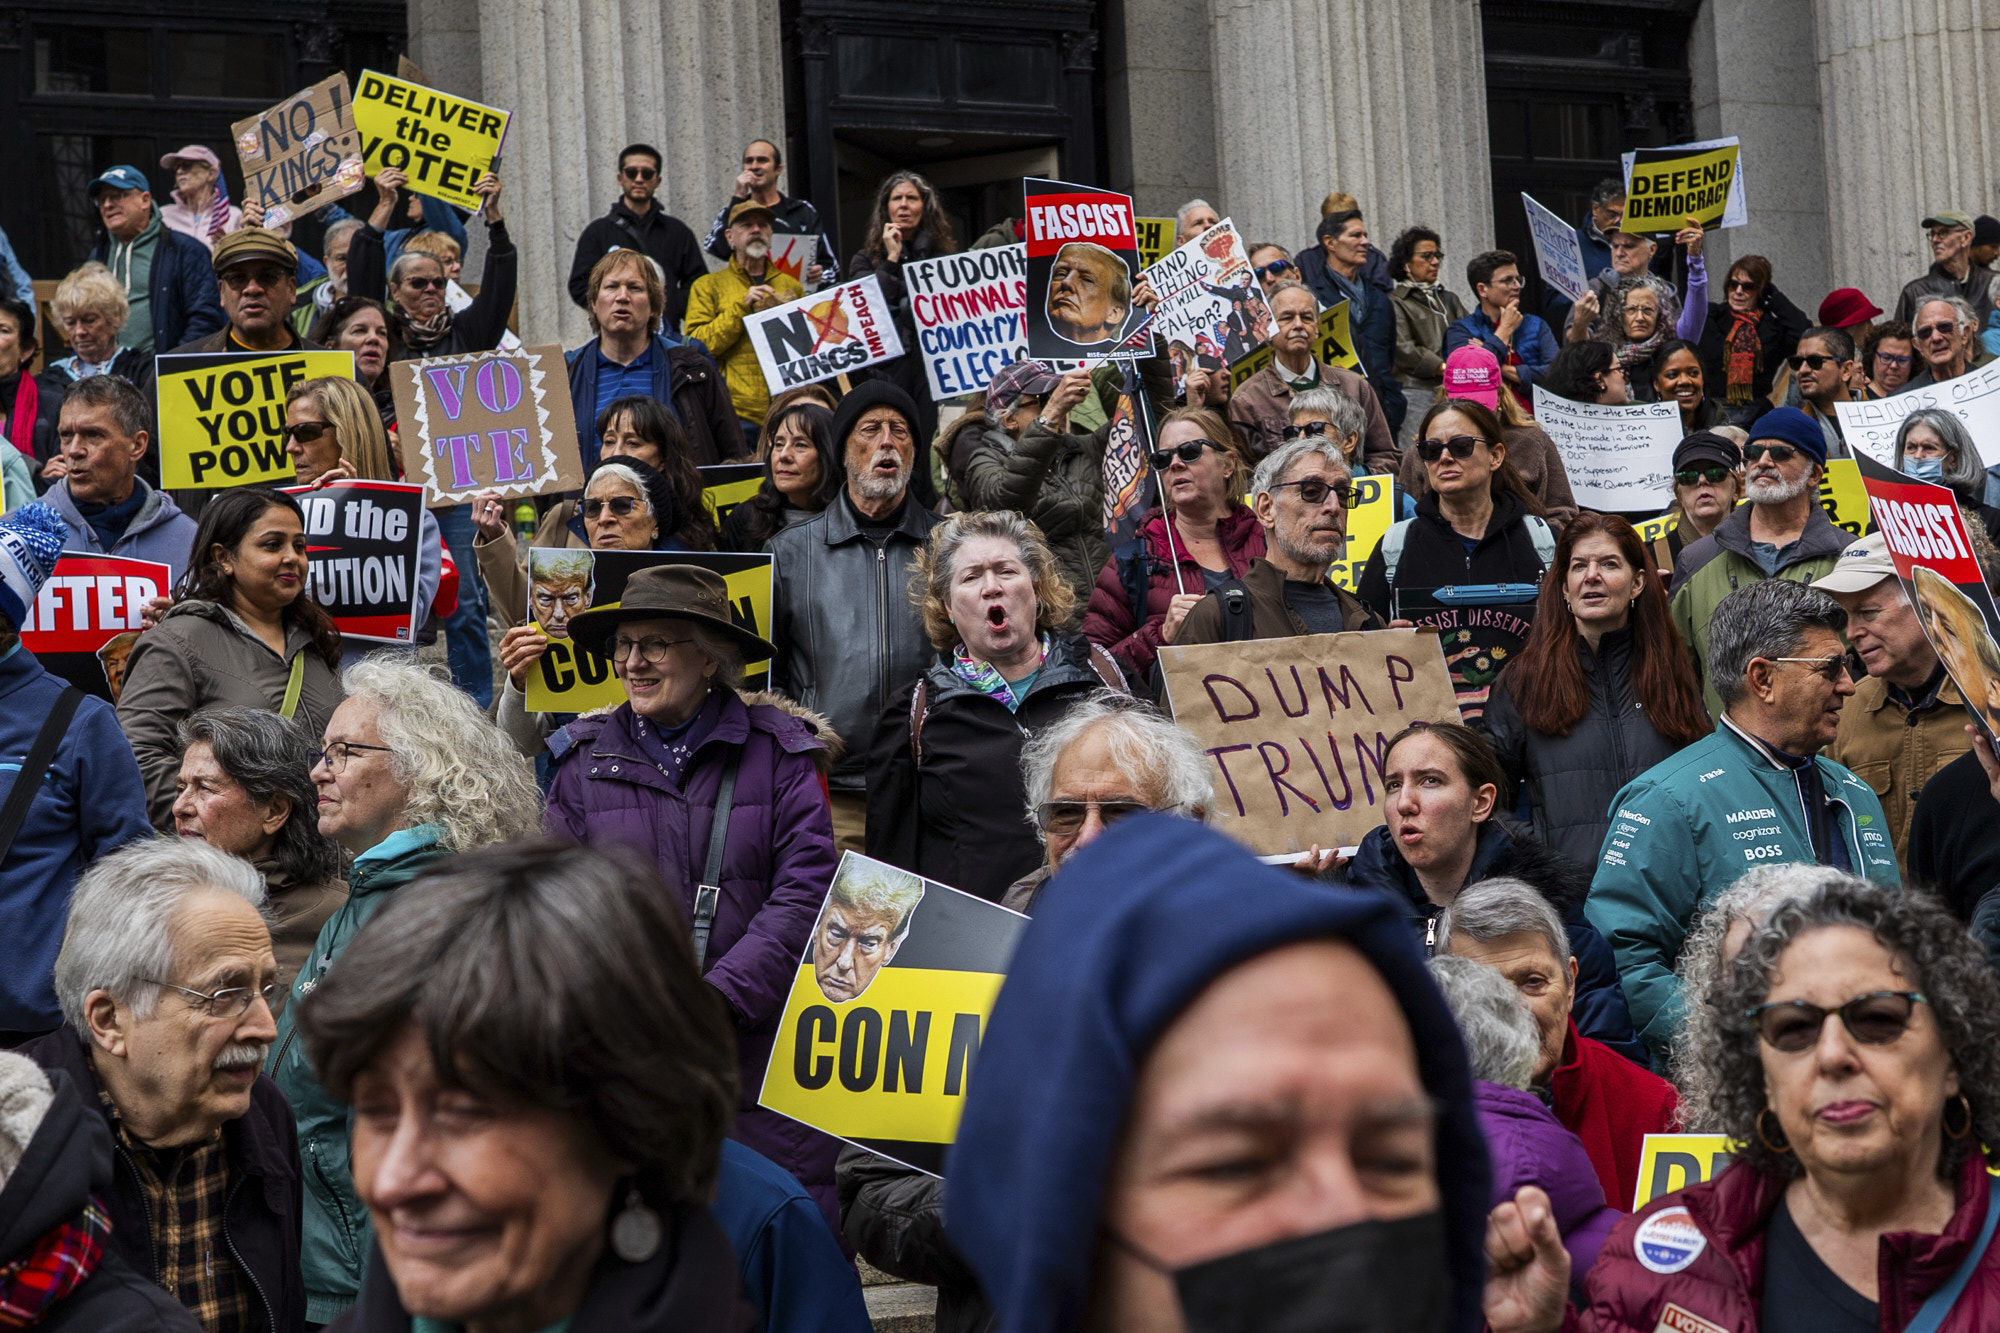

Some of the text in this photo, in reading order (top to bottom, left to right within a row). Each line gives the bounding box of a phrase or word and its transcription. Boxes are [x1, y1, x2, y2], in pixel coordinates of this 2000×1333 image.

[361, 77, 502, 139] DELIVER
[261, 101, 315, 162] NO
[396, 116, 451, 152] the
[256, 137, 342, 209] KINGS
[358, 131, 482, 196] VOTE!
[1632, 159, 1731, 196] DEFEND
[1629, 179, 1732, 219] DEMOCRACY
[1030, 203, 1131, 241] FASCIST
[1200, 223, 1230, 249] ATOMS
[1177, 284, 1203, 305] WILL
[848, 284, 886, 358] IMPEACH
[1157, 307, 1196, 336] FALL
[1188, 299, 1223, 335] FOR?
[777, 341, 868, 387] KINGS
[425, 359, 523, 421] VO
[1844, 369, 2000, 425] HANDS OFF
[1577, 421, 1599, 431] War
[1617, 424, 1647, 433] Iran
[1625, 407, 1647, 417] Fed
[1866, 429, 1896, 441] Our
[435, 428, 534, 490] TE
[1103, 444, 1141, 529] AMERIC
[344, 499, 409, 542] the
[1870, 495, 1970, 560] FASCIST
[7, 539, 45, 593] FINISH
[20, 575, 158, 632] FTER
[1468, 608, 1531, 640] DISSENT.
[1202, 655, 1415, 724] DUMP
[1203, 721, 1431, 818] TRUM
[1705, 768, 1726, 781] TikTok
[1623, 809, 1651, 826] NexGen
[1732, 825, 1782, 841] cognizant
[1744, 844, 1783, 861] BOSS
[793, 1004, 932, 1095] CON
[1666, 1309, 1675, 1325] I
